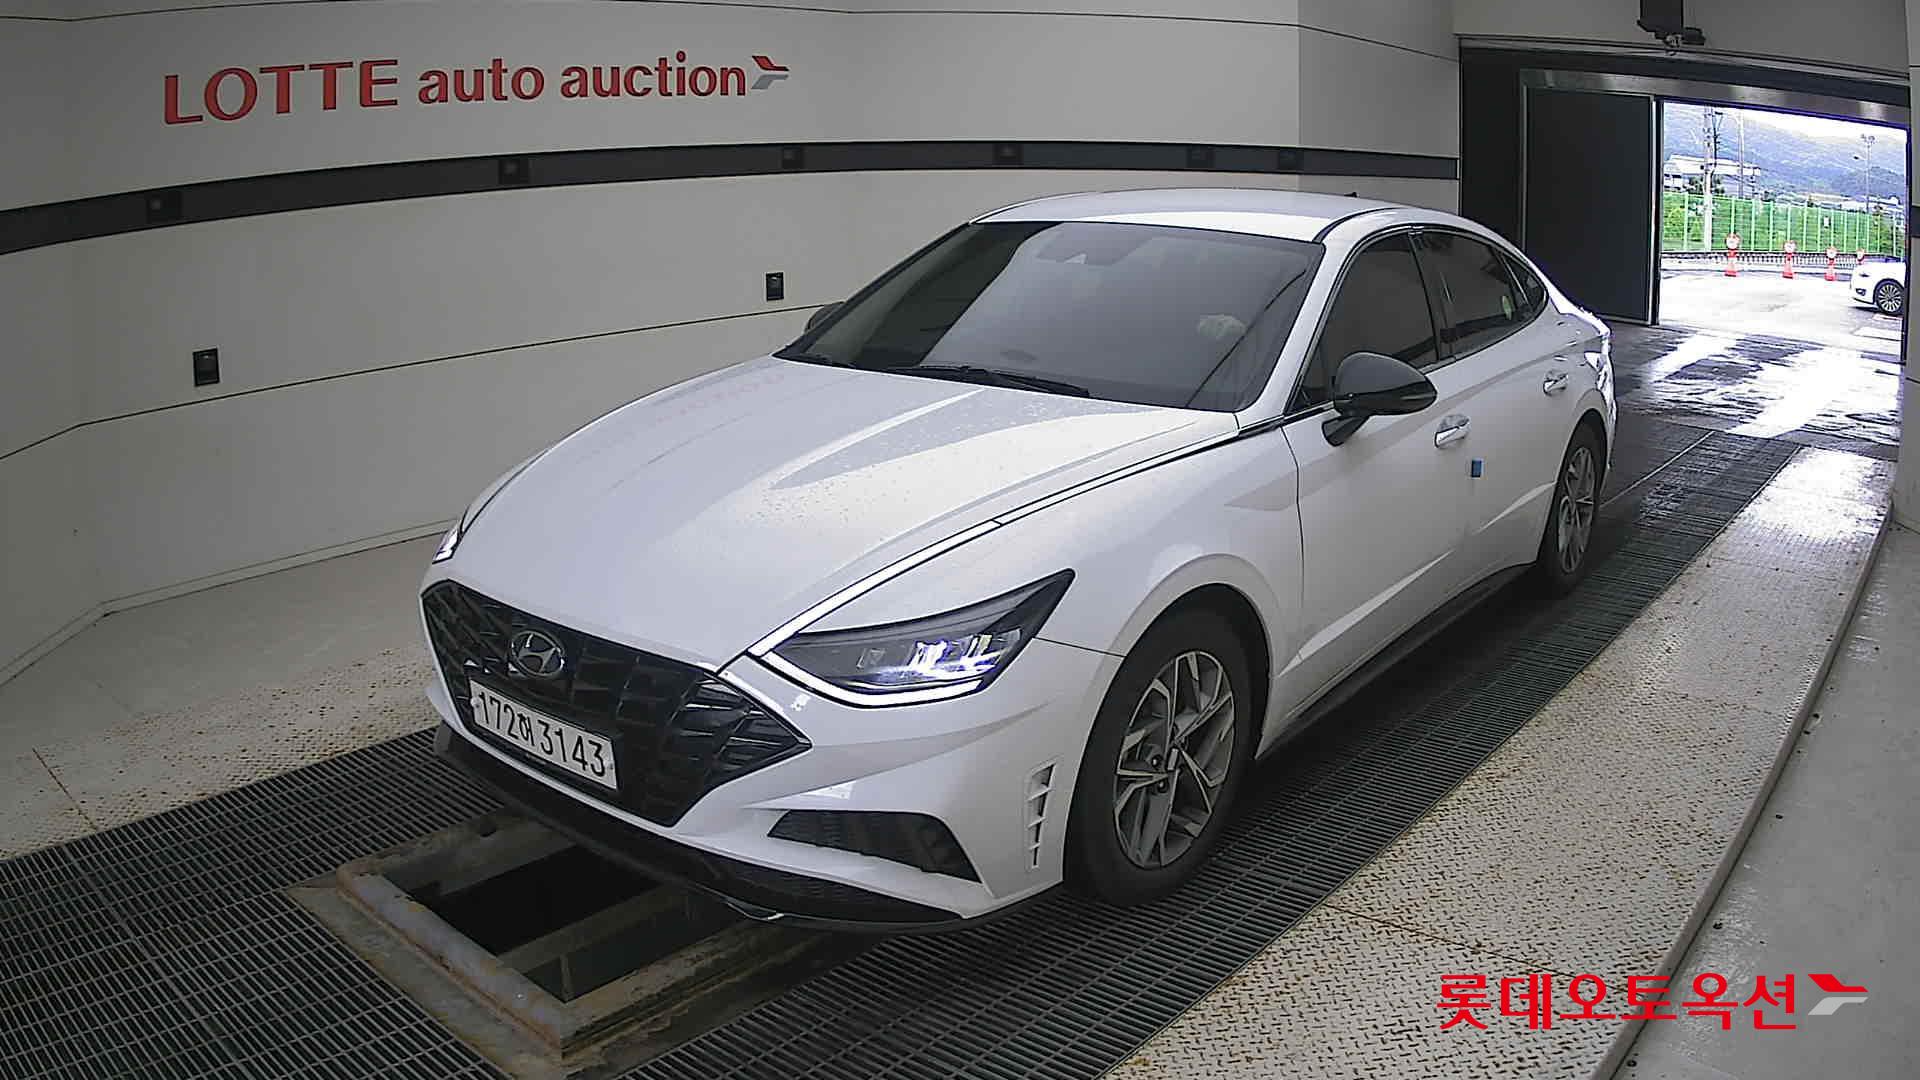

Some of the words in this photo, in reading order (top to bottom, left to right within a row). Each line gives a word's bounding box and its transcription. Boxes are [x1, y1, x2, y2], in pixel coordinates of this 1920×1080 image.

[164, 58, 399, 125] LOTTE
[418, 58, 545, 104] auto
[560, 50, 746, 98] auction
